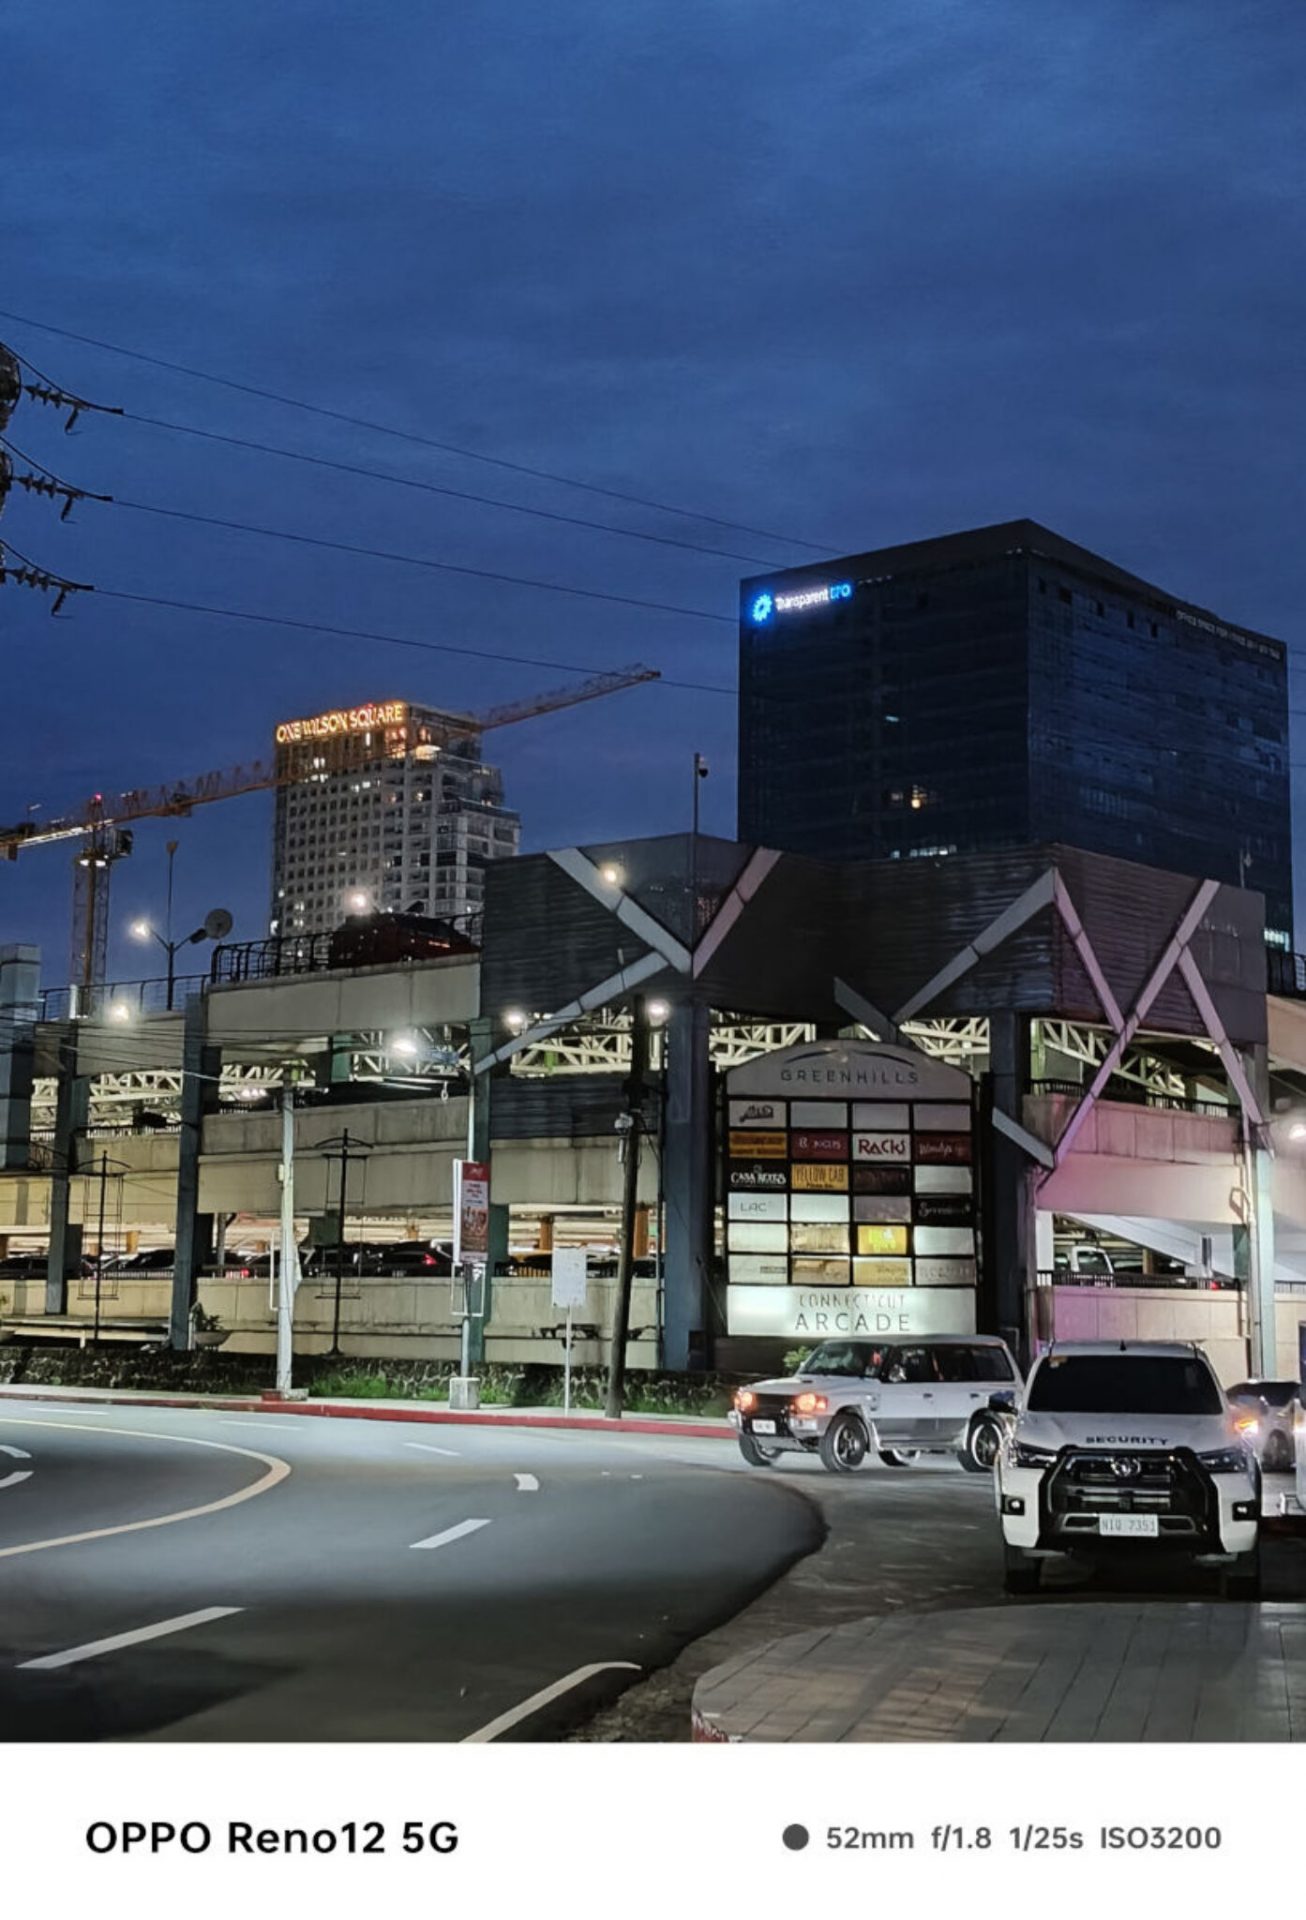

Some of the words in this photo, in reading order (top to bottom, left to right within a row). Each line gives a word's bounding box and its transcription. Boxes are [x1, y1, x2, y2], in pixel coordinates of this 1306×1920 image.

[276, 721, 302, 742] ONE
[303, 712, 348, 735] WILSON
[350, 704, 403, 728] SQUARE
[780, 1069, 919, 1085] GREENHILLS
[858, 1138, 906, 1155] RACKS
[794, 1312, 911, 1331] ARCADE
[1085, 1435, 1169, 1446] SECURITY
